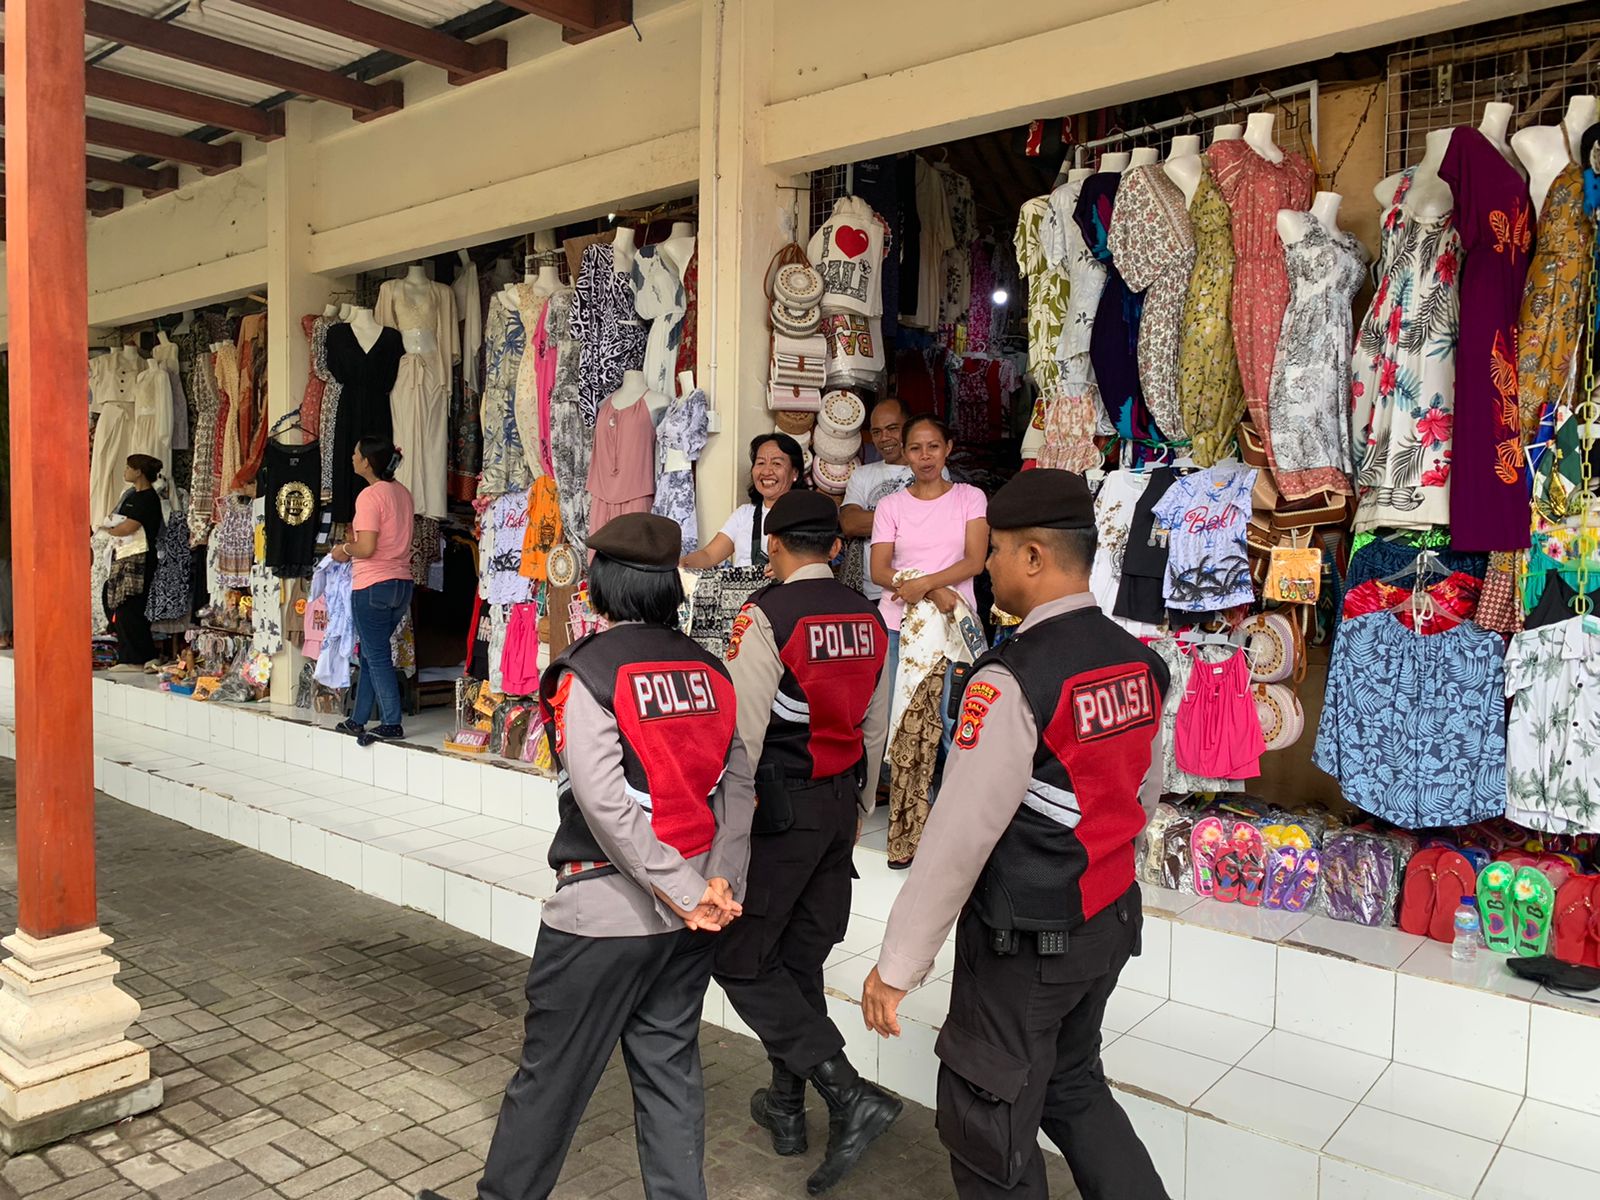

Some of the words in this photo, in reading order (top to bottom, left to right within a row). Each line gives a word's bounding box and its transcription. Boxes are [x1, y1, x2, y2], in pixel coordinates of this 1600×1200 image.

[1184, 502, 1237, 534] Bali
[809, 622, 876, 660] POLISI
[633, 671, 717, 718] POLISI
[1076, 676, 1150, 735] POLISI
